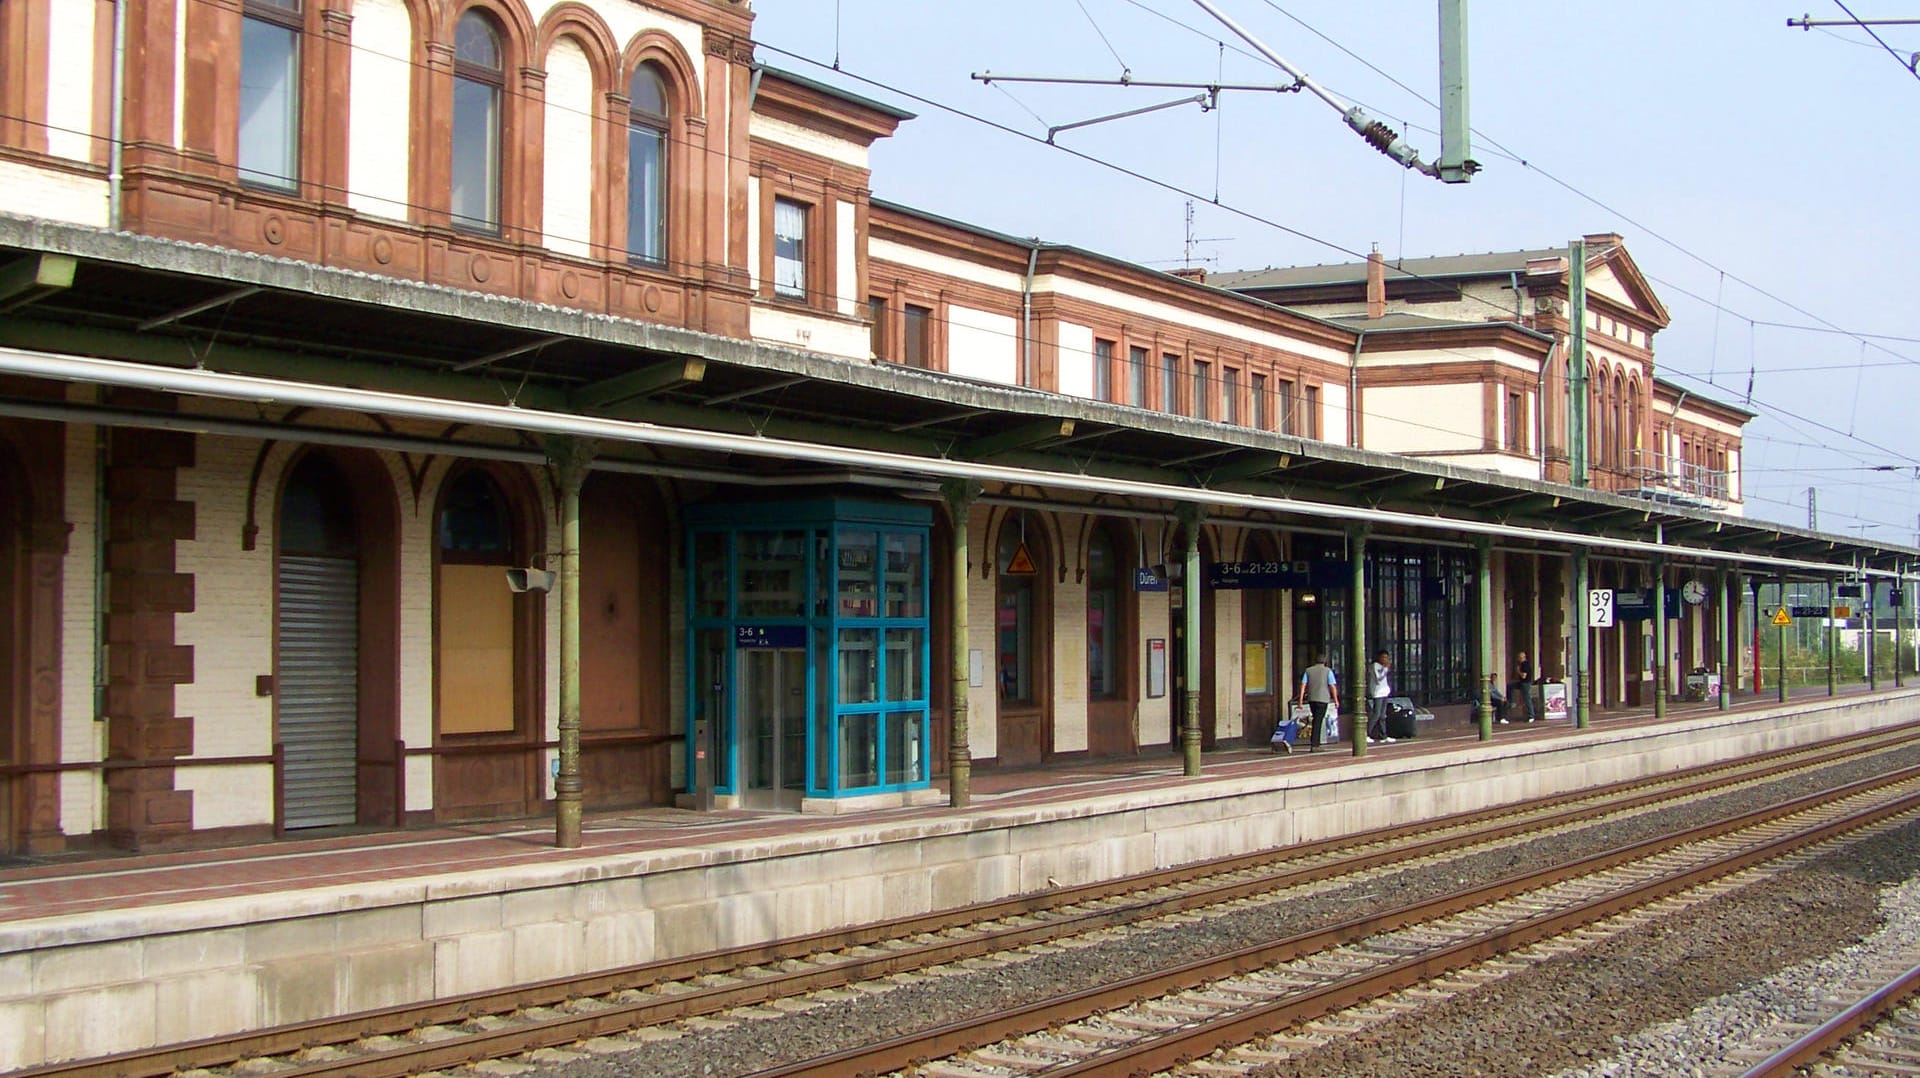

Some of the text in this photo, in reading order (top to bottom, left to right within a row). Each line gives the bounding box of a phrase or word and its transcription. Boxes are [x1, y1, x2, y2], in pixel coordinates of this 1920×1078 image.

[1221, 562, 1241, 574] 3-6
[1249, 562, 1279, 573] 21-23
[1591, 591, 1611, 607] 39
[1596, 607, 1606, 623] 2
[738, 627, 753, 637] 3-6
